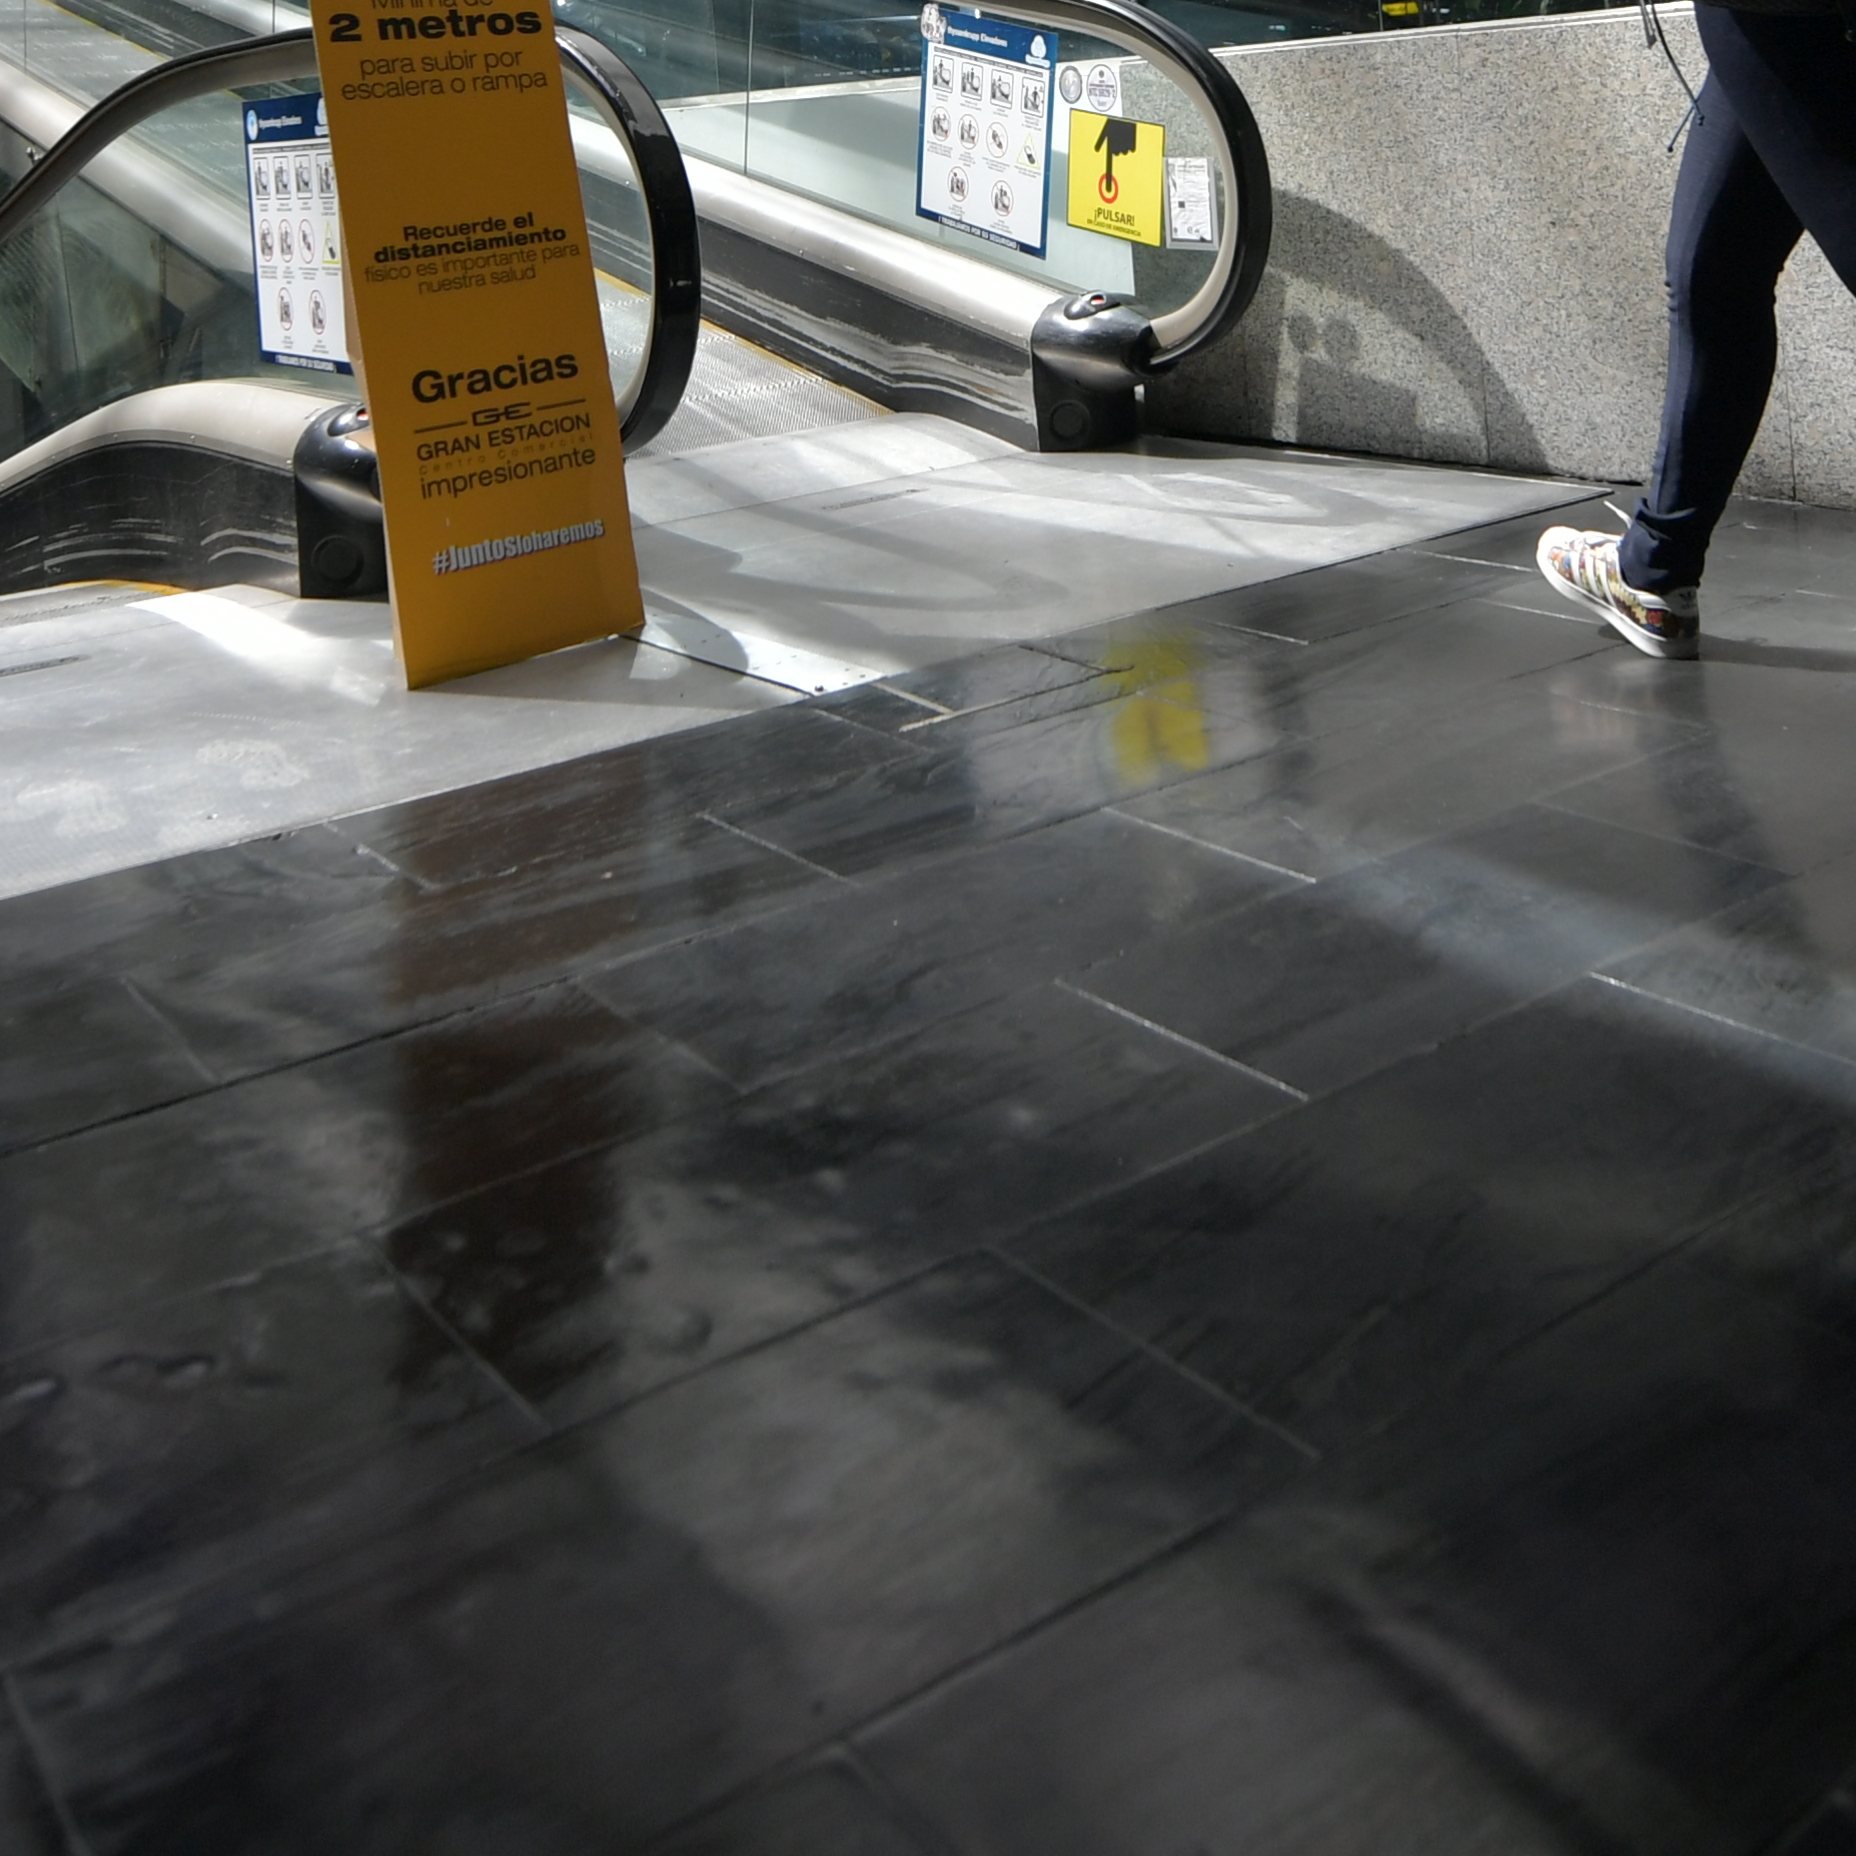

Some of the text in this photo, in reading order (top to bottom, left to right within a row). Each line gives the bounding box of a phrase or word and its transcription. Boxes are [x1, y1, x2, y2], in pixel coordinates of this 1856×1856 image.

[328, 10, 542, 43] 2 metros
[360, 48, 523, 81] para subir por
[340, 71, 548, 101] escalera o rampa
[403, 212, 535, 244] Recuerde el
[1094, 207, 1135, 226] ¡PULSAR!
[1113, 225, 1141, 236] EMERGENCIA
[374, 226, 567, 264] distanciamiento
[416, 261, 439, 277] es
[442, 246, 538, 277] importante
[542, 242, 580, 264] para
[418, 264, 537, 295] nuestra salud
[411, 352, 580, 404] Gracias
[415, 413, 592, 462] GRAN ESTACION
[418, 433, 593, 476] Centro Comercial
[420, 445, 597, 500] impresionante
